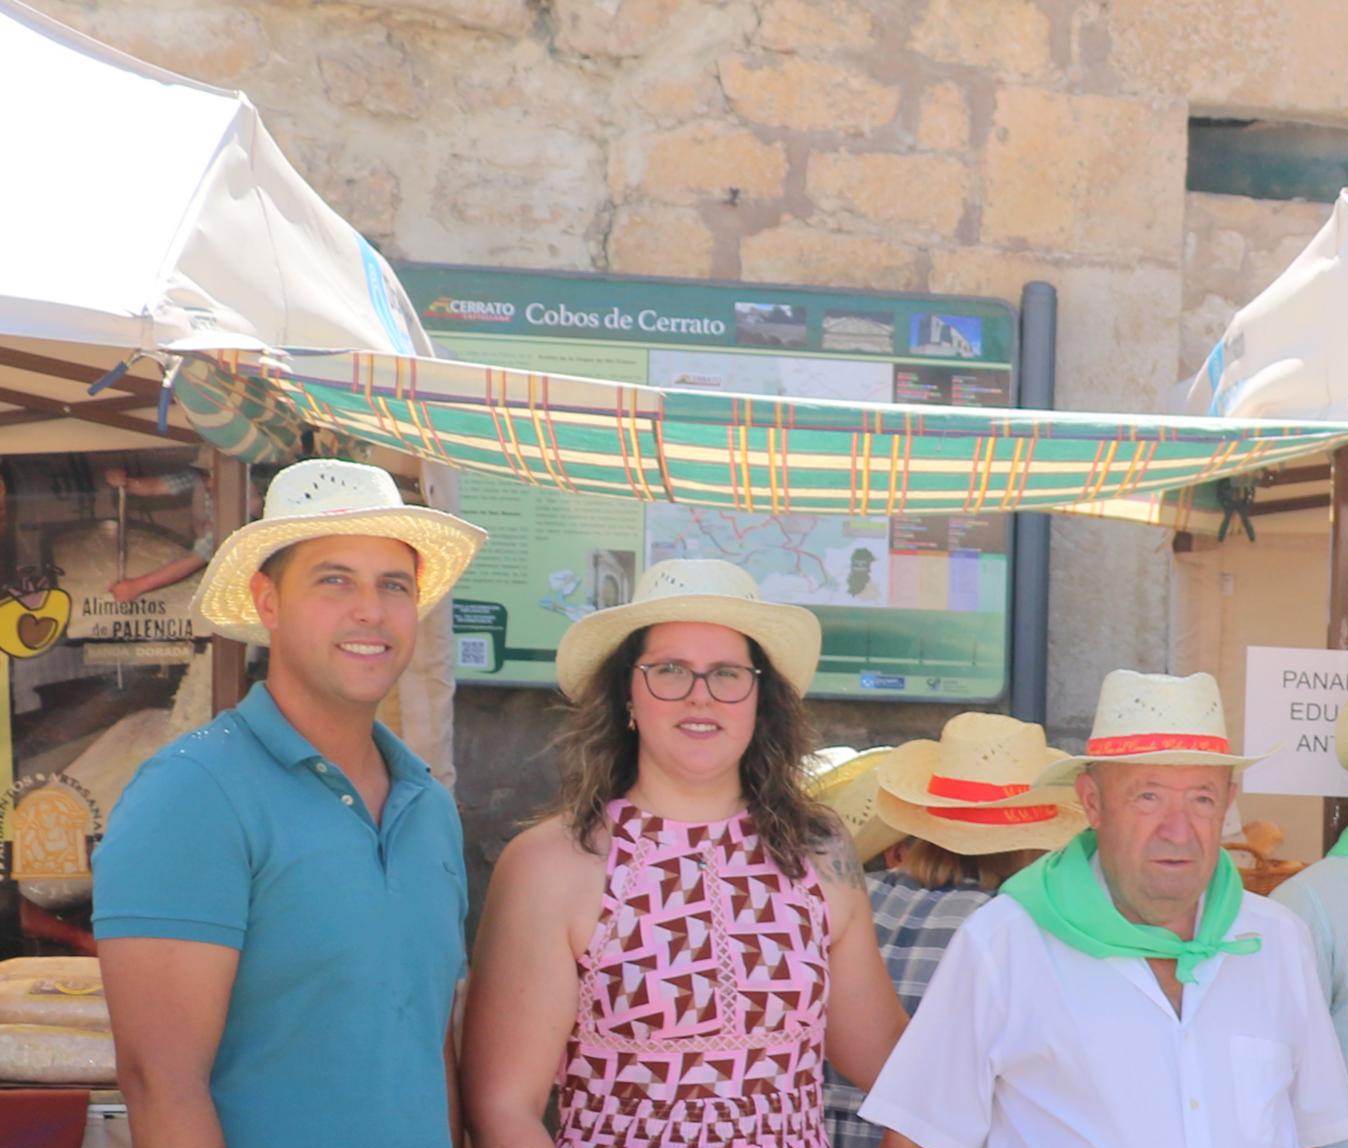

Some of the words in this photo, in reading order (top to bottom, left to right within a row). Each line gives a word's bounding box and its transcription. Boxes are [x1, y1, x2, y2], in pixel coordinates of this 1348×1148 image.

[450, 300, 515, 316] CERRATO
[525, 302, 599, 328] Cobos
[603, 306, 633, 331] de
[638, 308, 726, 336] Cerrato
[82, 597, 167, 617] Alimentos
[91, 623, 108, 637] de
[112, 619, 194, 638] PALENCIA
[135, 646, 190, 658] DORADA
[1289, 702, 1340, 723] EDU
[1295, 734, 1336, 753] AN
